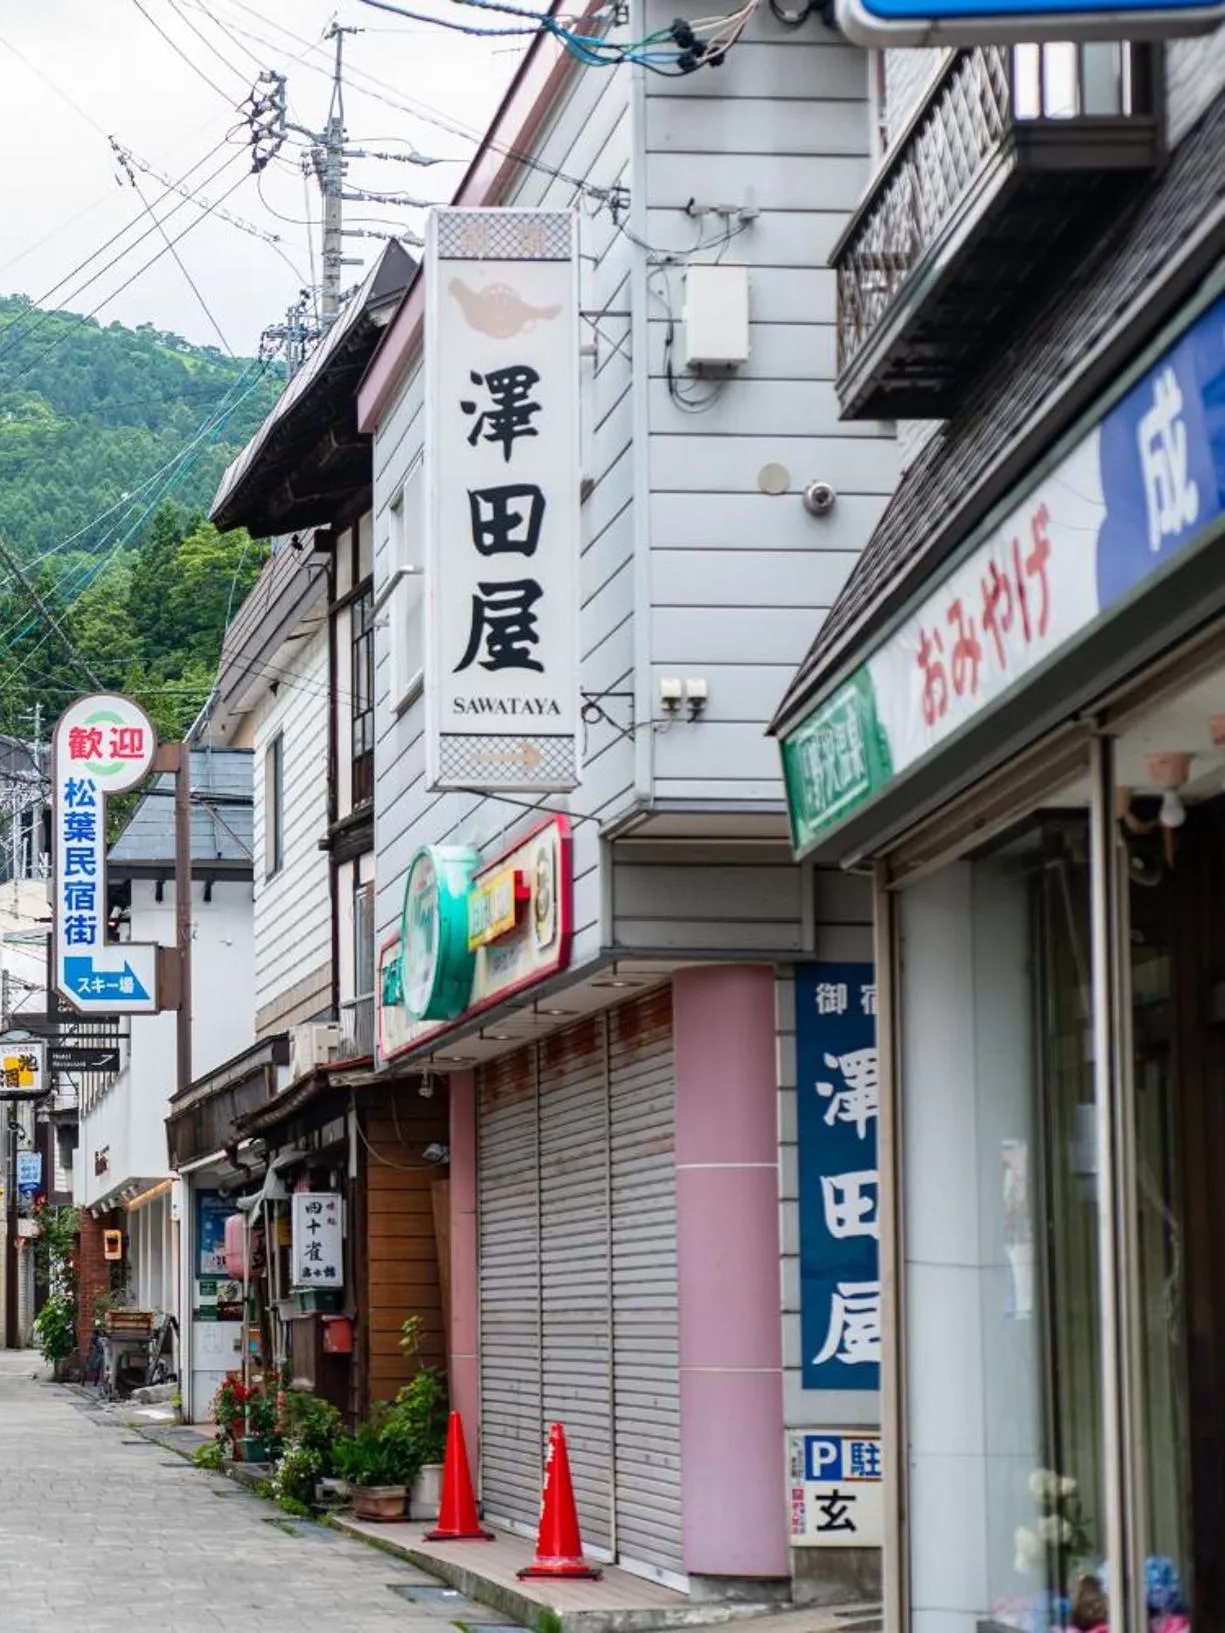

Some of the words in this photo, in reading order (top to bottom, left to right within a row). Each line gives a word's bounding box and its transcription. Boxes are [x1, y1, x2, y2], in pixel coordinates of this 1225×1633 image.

[452, 364, 546, 673] 澤田屋
[917, 504, 1051, 727] おみやげ
[452, 697, 562, 716] SAWATAYA
[68, 726, 145, 760] 歓迎
[63, 777, 96, 946] 松葉民宿街
[78, 976, 135, 994] スキー場
[811, 1441, 837, 1477] P
